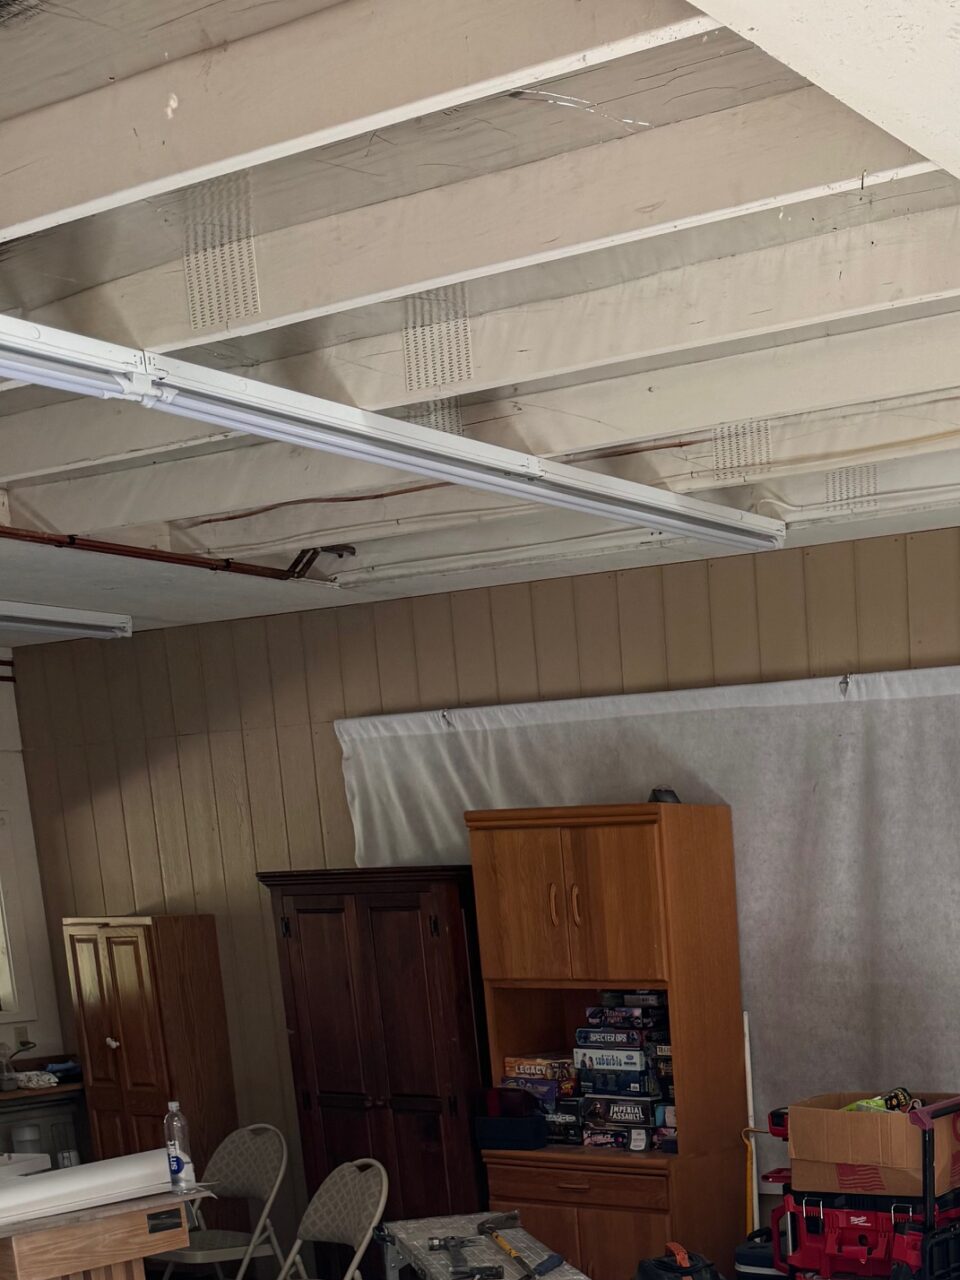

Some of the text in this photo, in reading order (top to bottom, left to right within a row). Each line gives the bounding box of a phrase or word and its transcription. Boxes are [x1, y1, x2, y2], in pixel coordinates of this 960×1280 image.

[590, 1033, 627, 1042] SPECTER OPS
[515, 1065, 546, 1075] LEGACY
[610, 1104, 644, 1117] IMPERIAL
[612, 1113, 641, 1121] ASSAULT
